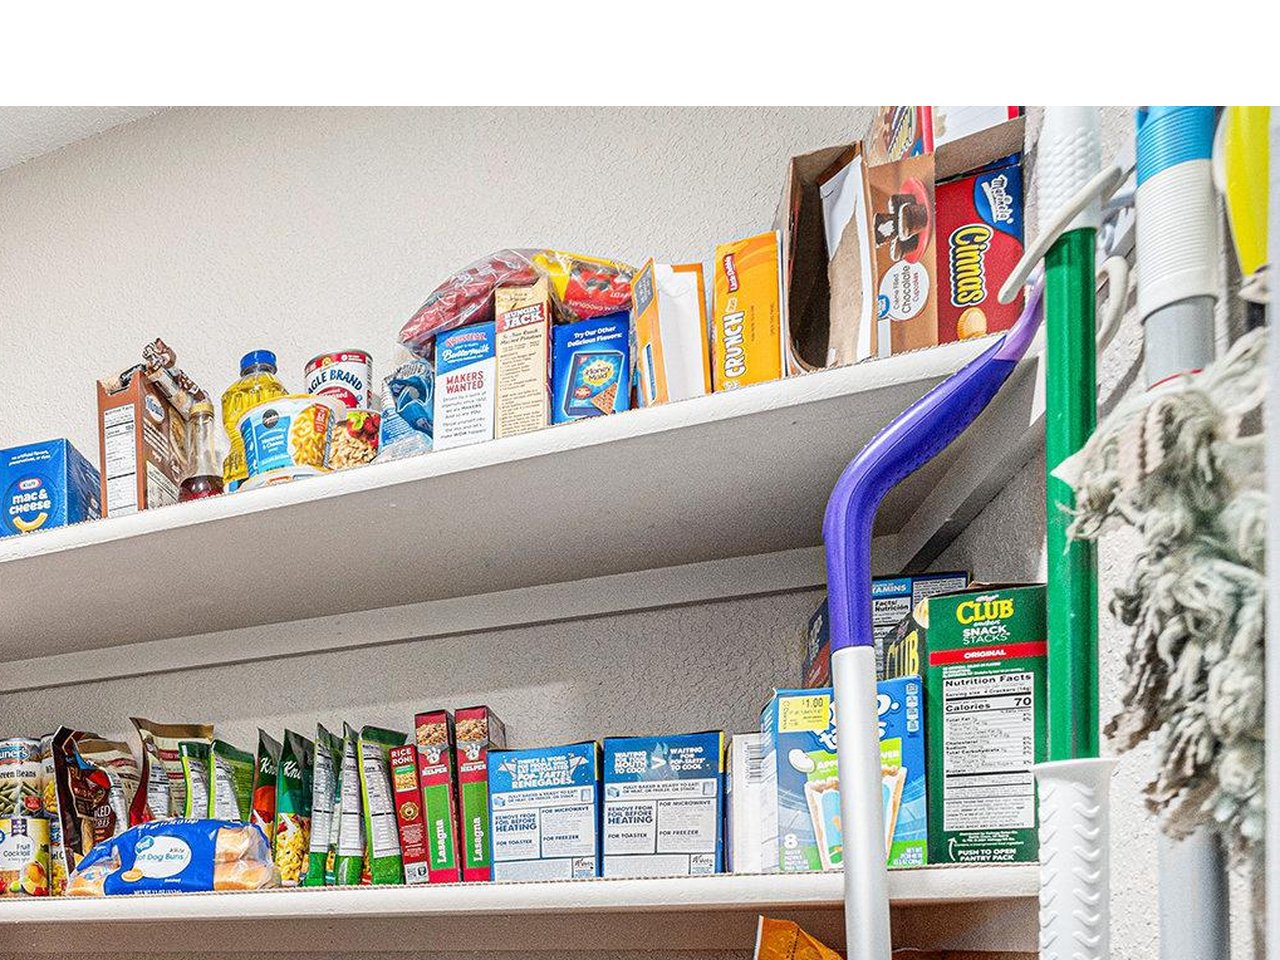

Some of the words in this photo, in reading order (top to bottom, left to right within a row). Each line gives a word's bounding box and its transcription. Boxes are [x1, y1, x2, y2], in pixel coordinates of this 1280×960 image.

[951, 225, 993, 306] Cinnas
[901, 265, 911, 313] Chocolate
[503, 311, 544, 329] JACK
[598, 326, 616, 334] Other
[567, 337, 596, 348] Delicious
[723, 311, 746, 377] CRUNCH
[330, 369, 363, 391] BRAND
[446, 371, 484, 384] MAKERS
[446, 381, 484, 394] WANTED
[956, 600, 1014, 624] CLUB
[963, 625, 1007, 637] SNACK
[963, 634, 1008, 645] STACKS
[964, 650, 1006, 659] ORIGINAL
[946, 678, 996, 687] Nutrition
[1000, 674, 1031, 682] Facts
[946, 703, 991, 712] Calories
[1014, 697, 1031, 706] 70
[391, 748, 412, 757] RICE
[608, 816, 653, 825] HEATING
[495, 824, 537, 832] HEATING
[437, 819, 447, 863] Lasagna
[473, 817, 483, 862] Lasagna
[147, 853, 164, 863] Dog
